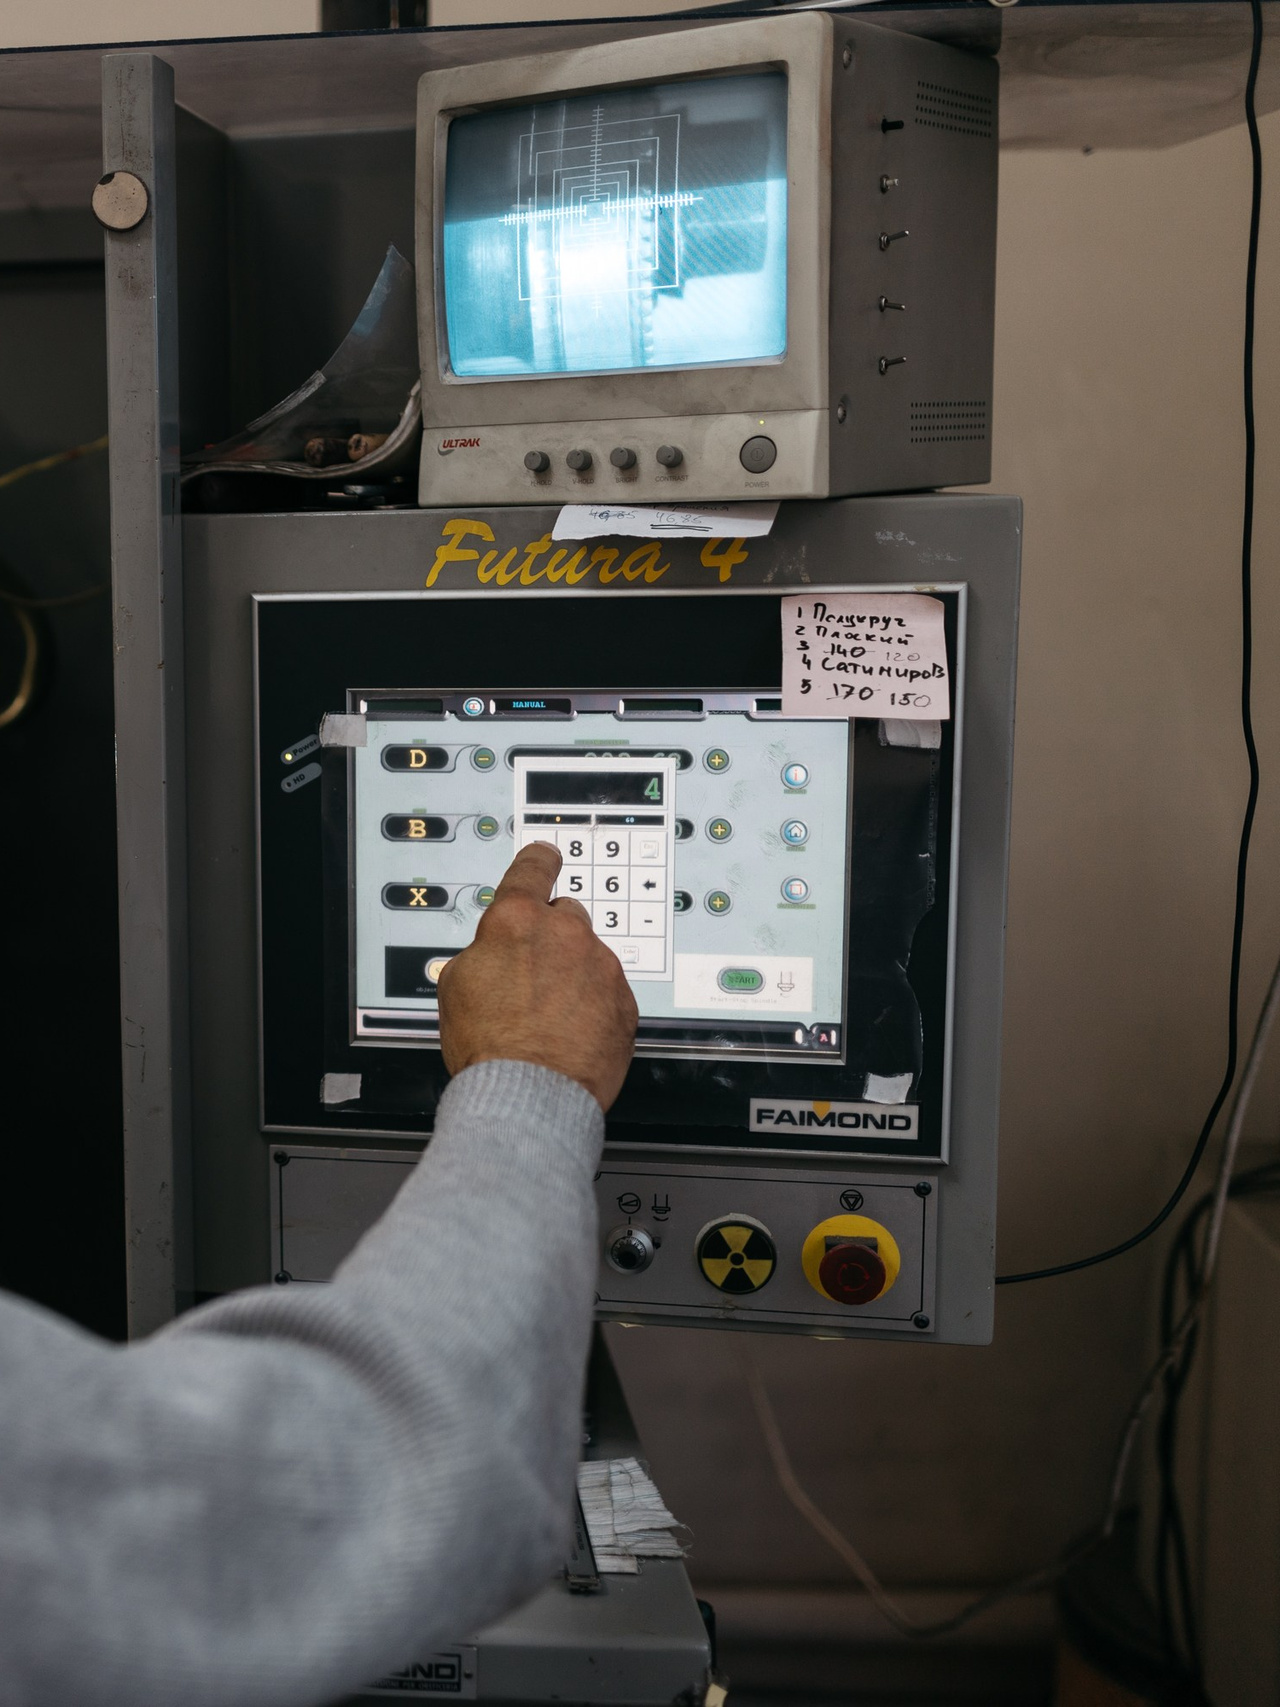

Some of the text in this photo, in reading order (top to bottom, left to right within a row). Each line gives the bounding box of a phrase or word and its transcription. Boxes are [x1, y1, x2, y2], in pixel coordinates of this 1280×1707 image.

[442, 437, 481, 449] ULTRAK
[615, 476, 638, 484] BRIGHT
[745, 481, 770, 489] POWER
[425, 518, 749, 588] Futura 4
[797, 606, 803, 618] 1
[795, 625, 806, 636] 2
[796, 640, 810, 651] 3
[886, 651, 921, 662] 120
[802, 653, 812, 671] 4
[800, 678, 932, 708] 5 170 150
[512, 701, 546, 709] MANUAL
[292, 739, 318, 756] Power
[409, 749, 427, 768] D
[292, 773, 306, 785] HD
[644, 777, 661, 800] 4
[408, 819, 427, 838] B
[569, 841, 583, 857] 8
[606, 841, 620, 858] 9
[569, 876, 583, 892] 5
[605, 876, 620, 893] 6
[409, 888, 428, 906] X
[605, 911, 619, 928] 3
[819, 1033, 828, 1042] A
[756, 1108, 912, 1131] FAIMOND
